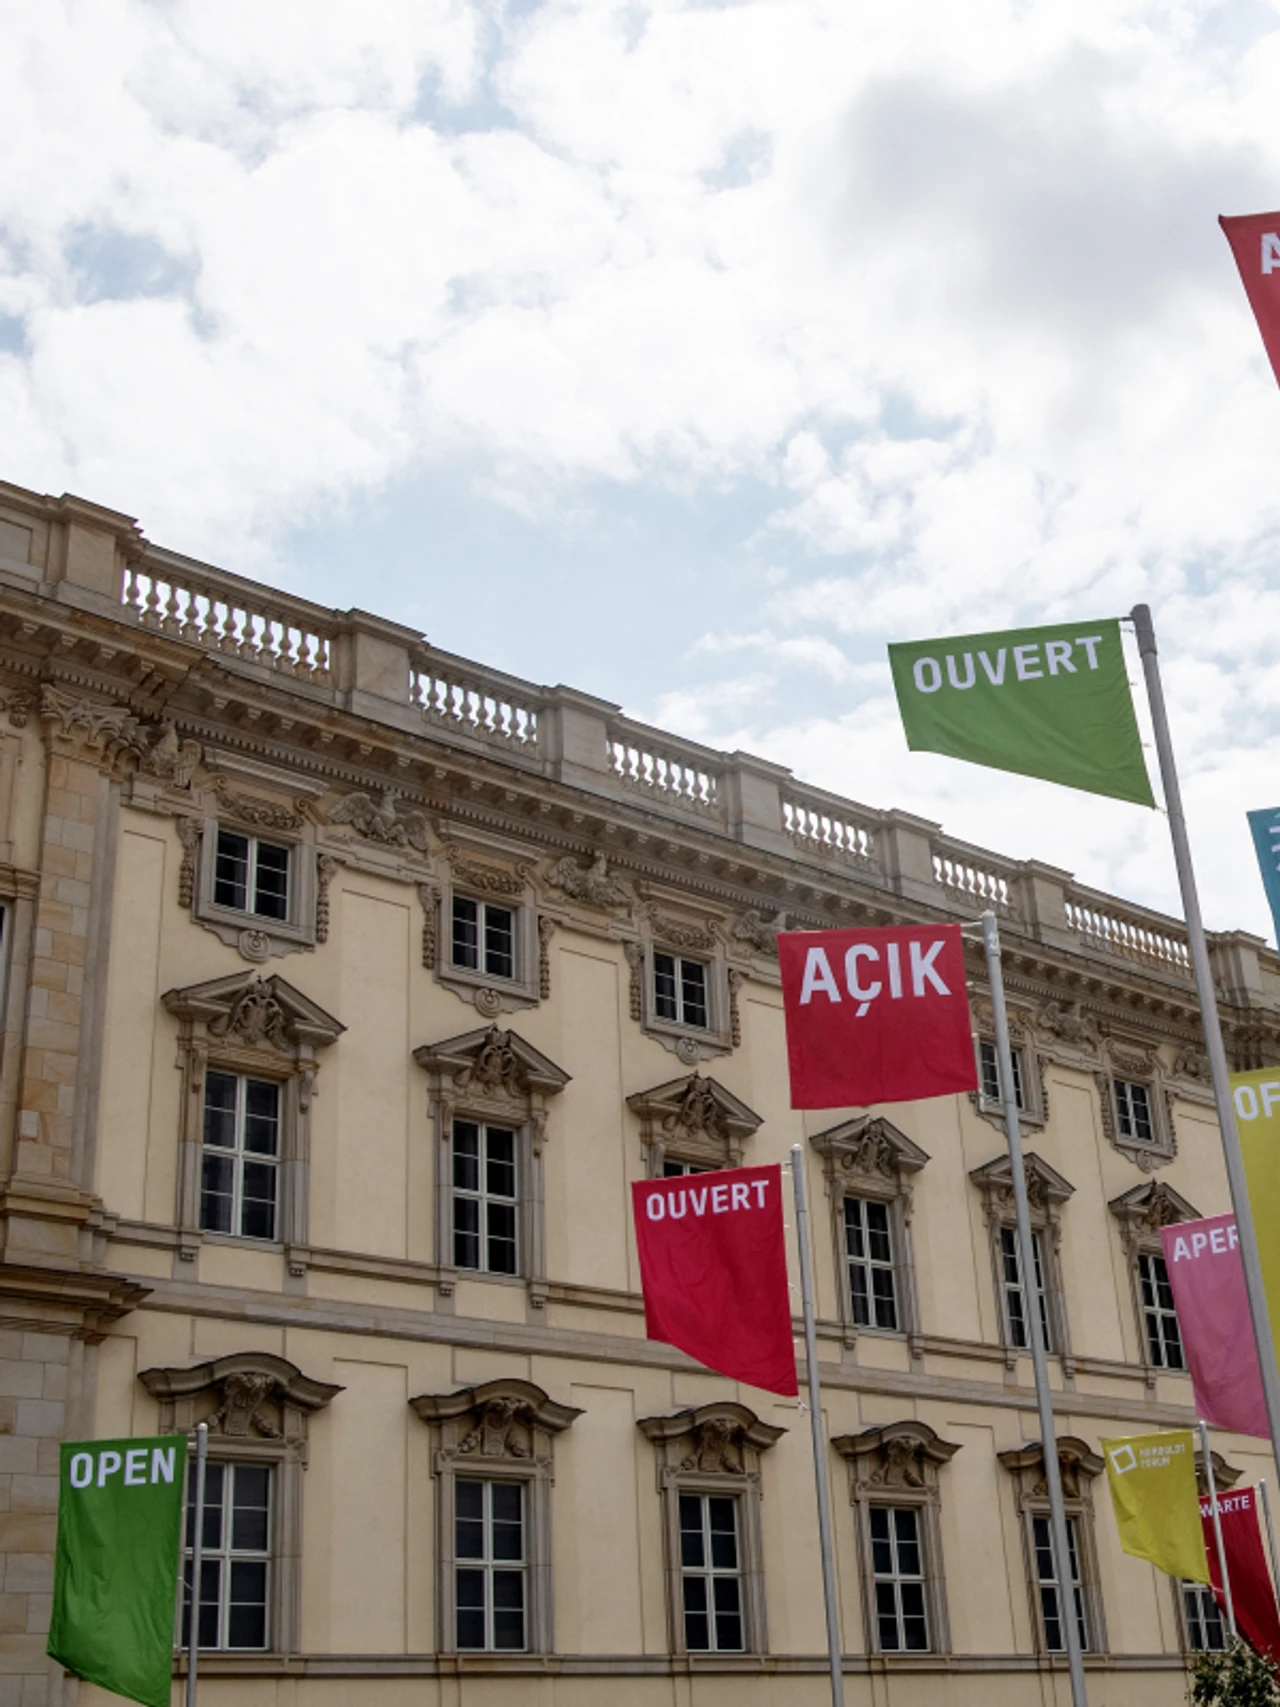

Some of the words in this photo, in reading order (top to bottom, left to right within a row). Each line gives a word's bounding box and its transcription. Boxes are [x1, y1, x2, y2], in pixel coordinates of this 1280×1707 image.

[914, 636, 1102, 693] OUVERT
[800, 941, 951, 1016] AÇIK
[647, 1180, 769, 1220] OUVERT
[71, 1447, 175, 1488] OPEN
